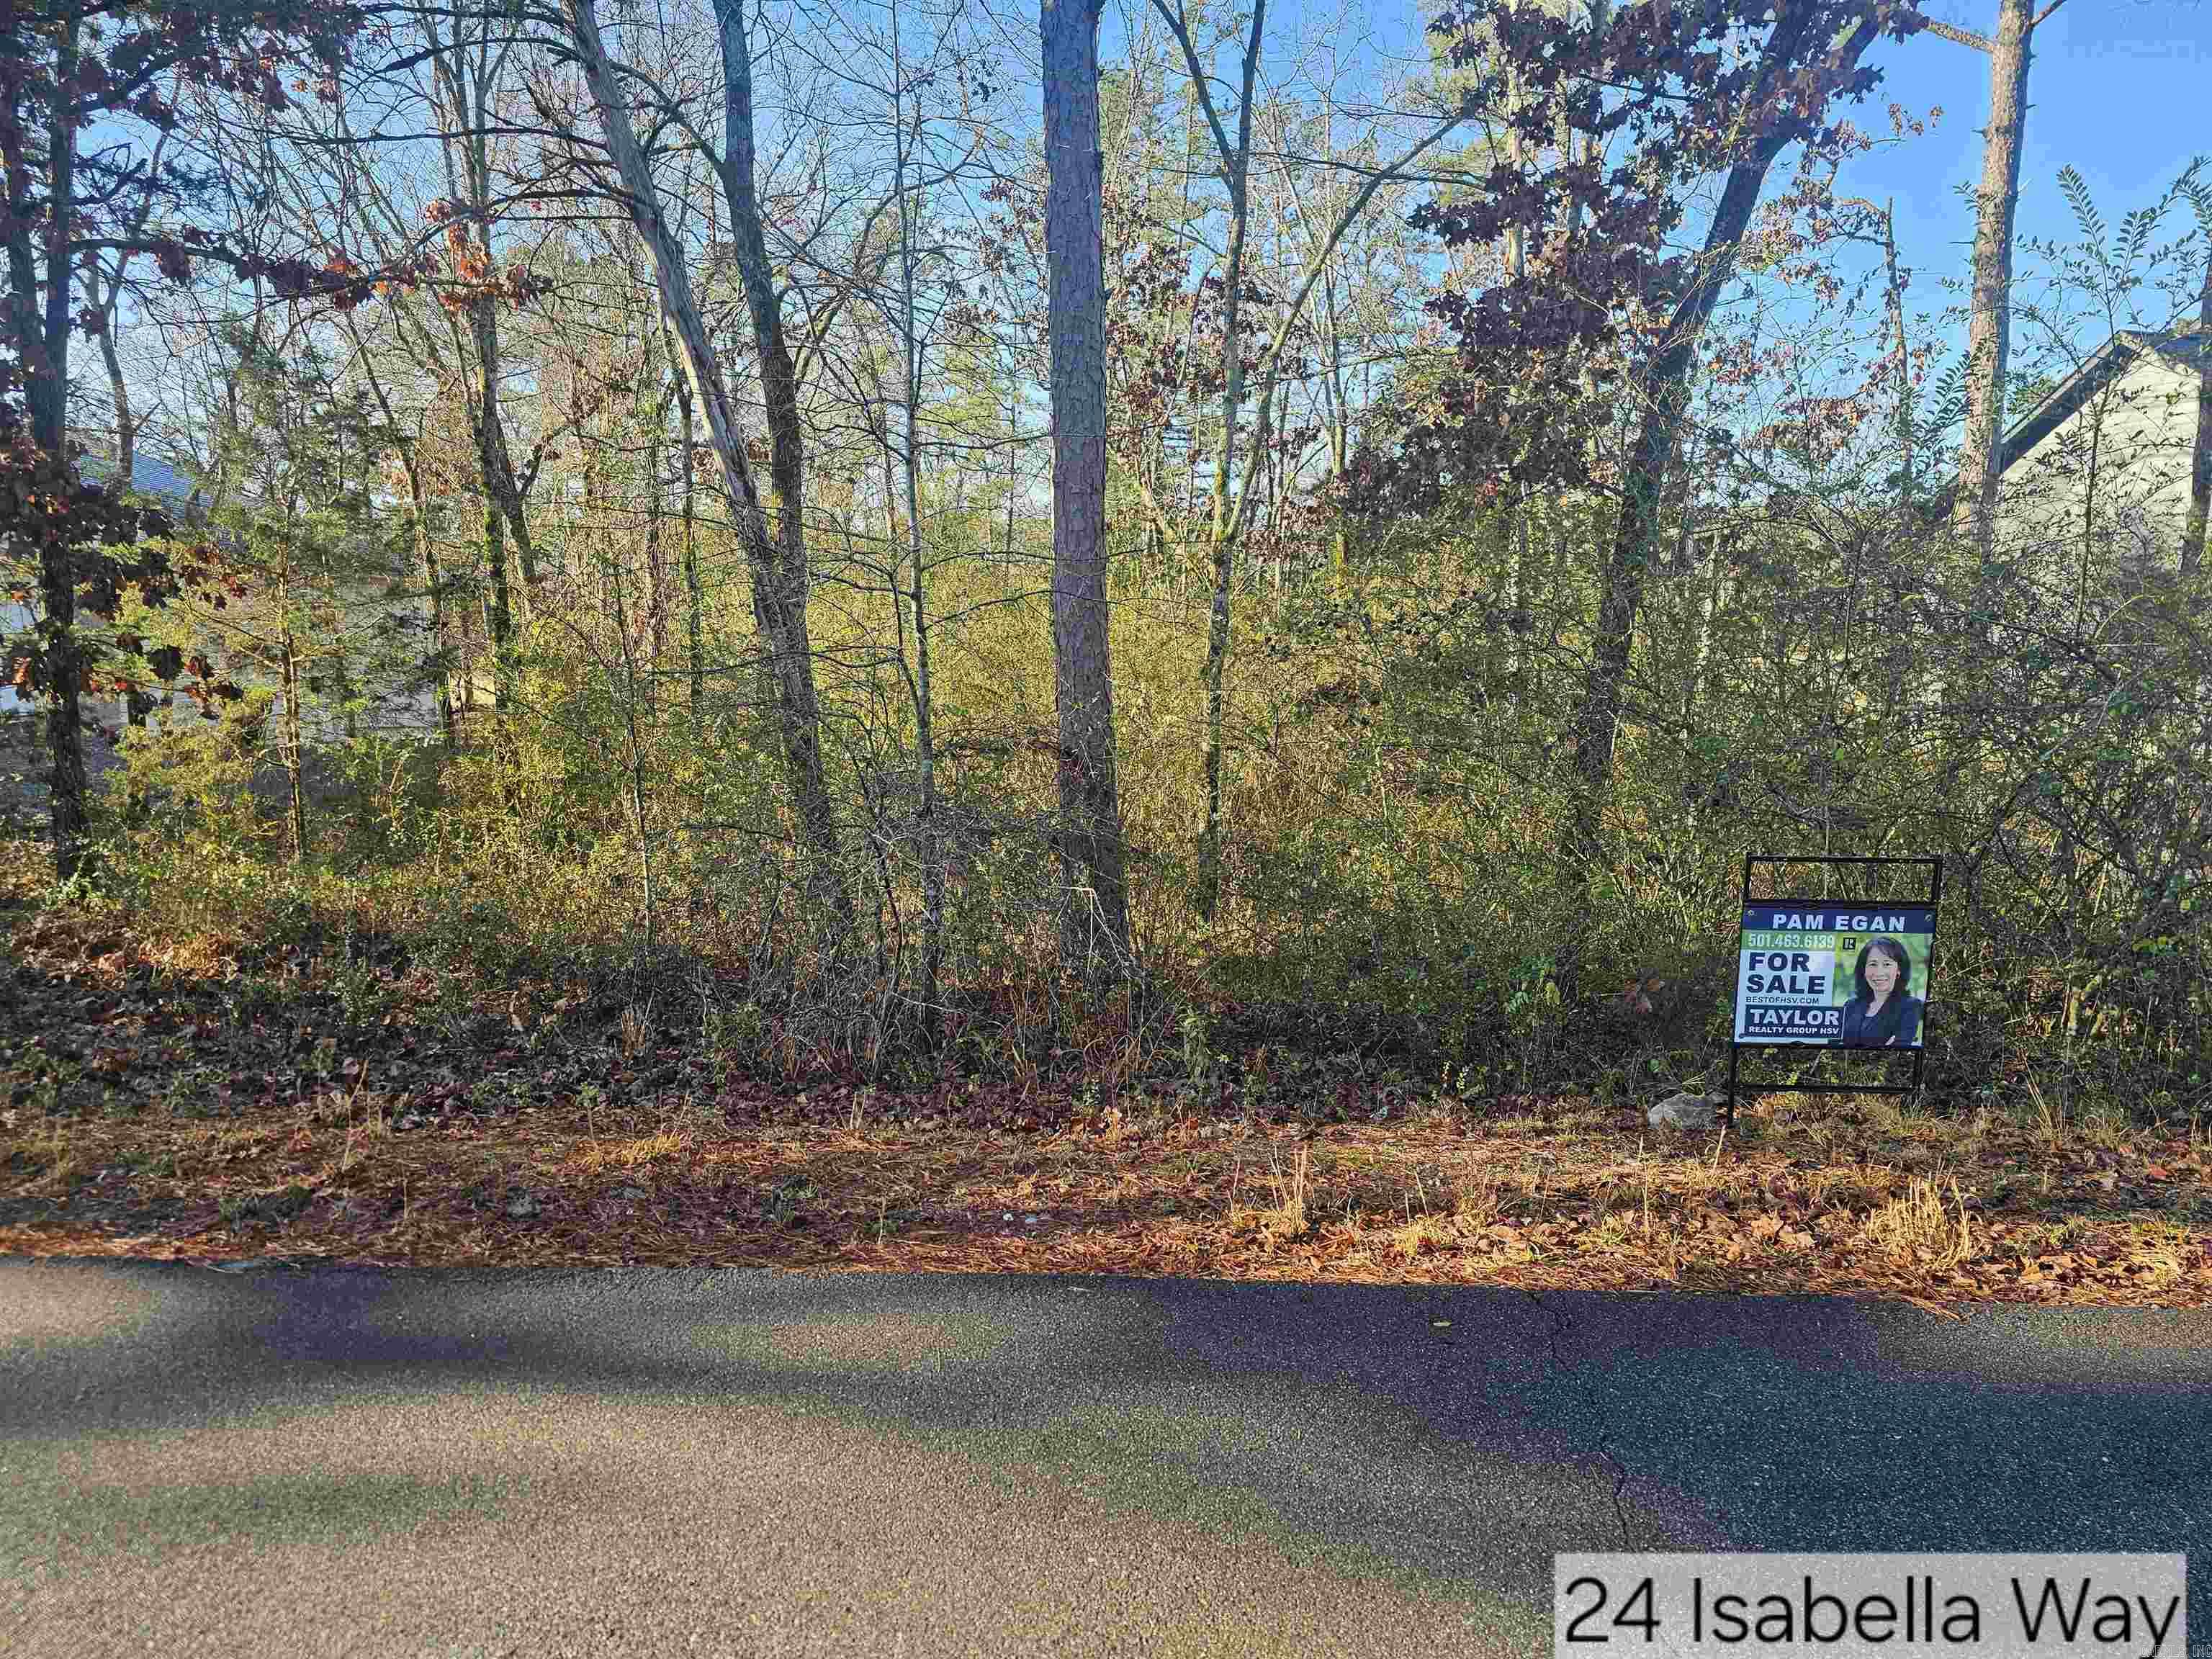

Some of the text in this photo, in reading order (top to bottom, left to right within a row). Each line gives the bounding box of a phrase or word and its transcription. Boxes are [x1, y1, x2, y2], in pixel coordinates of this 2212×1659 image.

[1772, 914, 1906, 932] PAM EGAN
[1748, 932, 1834, 948] 501.463.6139
[1748, 952, 1809, 972] FOR
[1746, 974, 1826, 994] SALE
[1745, 996, 1820, 1004] BESTOFHSV.COM
[1750, 1009, 1839, 1025] TAYLOR
